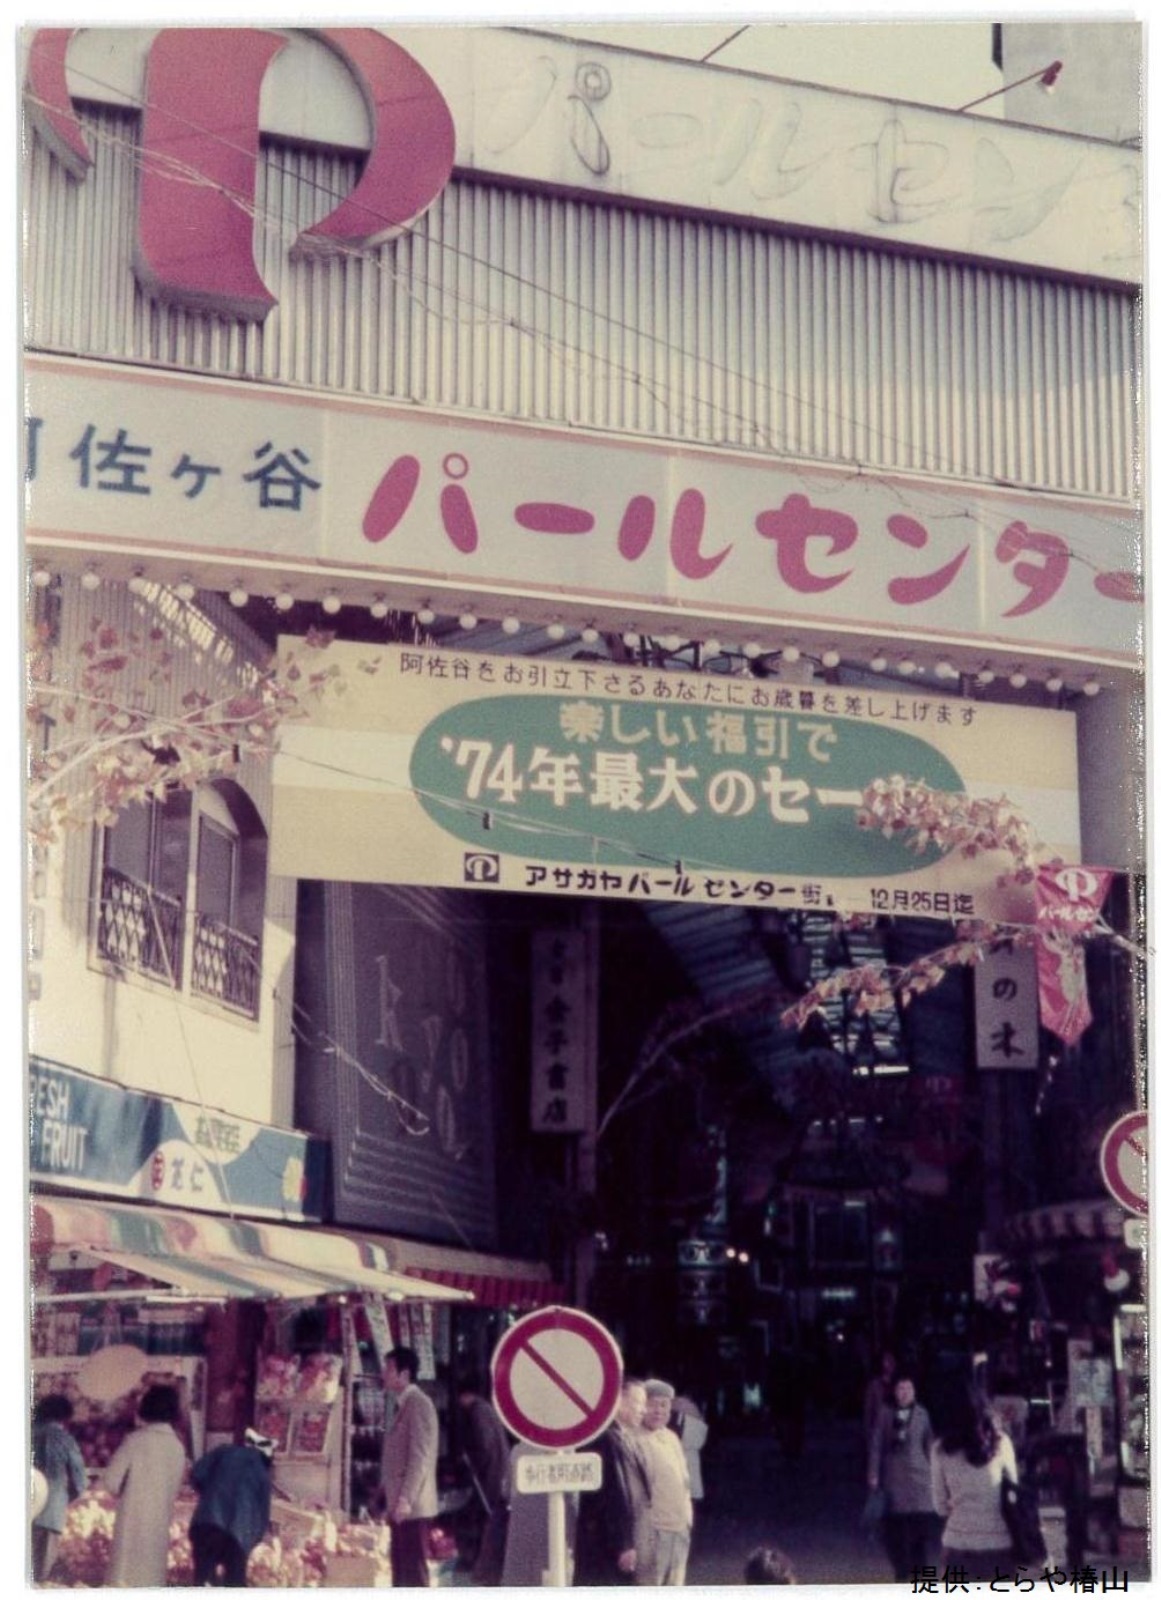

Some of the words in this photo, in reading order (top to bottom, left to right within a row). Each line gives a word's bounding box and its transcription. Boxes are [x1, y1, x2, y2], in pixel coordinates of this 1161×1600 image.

[361, 451, 1145, 619] パールセンター
[400, 652, 977, 727] 阿佐谷をお引立下さるあなたにお歳暮を差し上げます
[559, 699, 839, 763] 楽しい福引で
[870, 887, 976, 916] 12月25日迄
[42, 1118, 88, 1172] FRUIT
